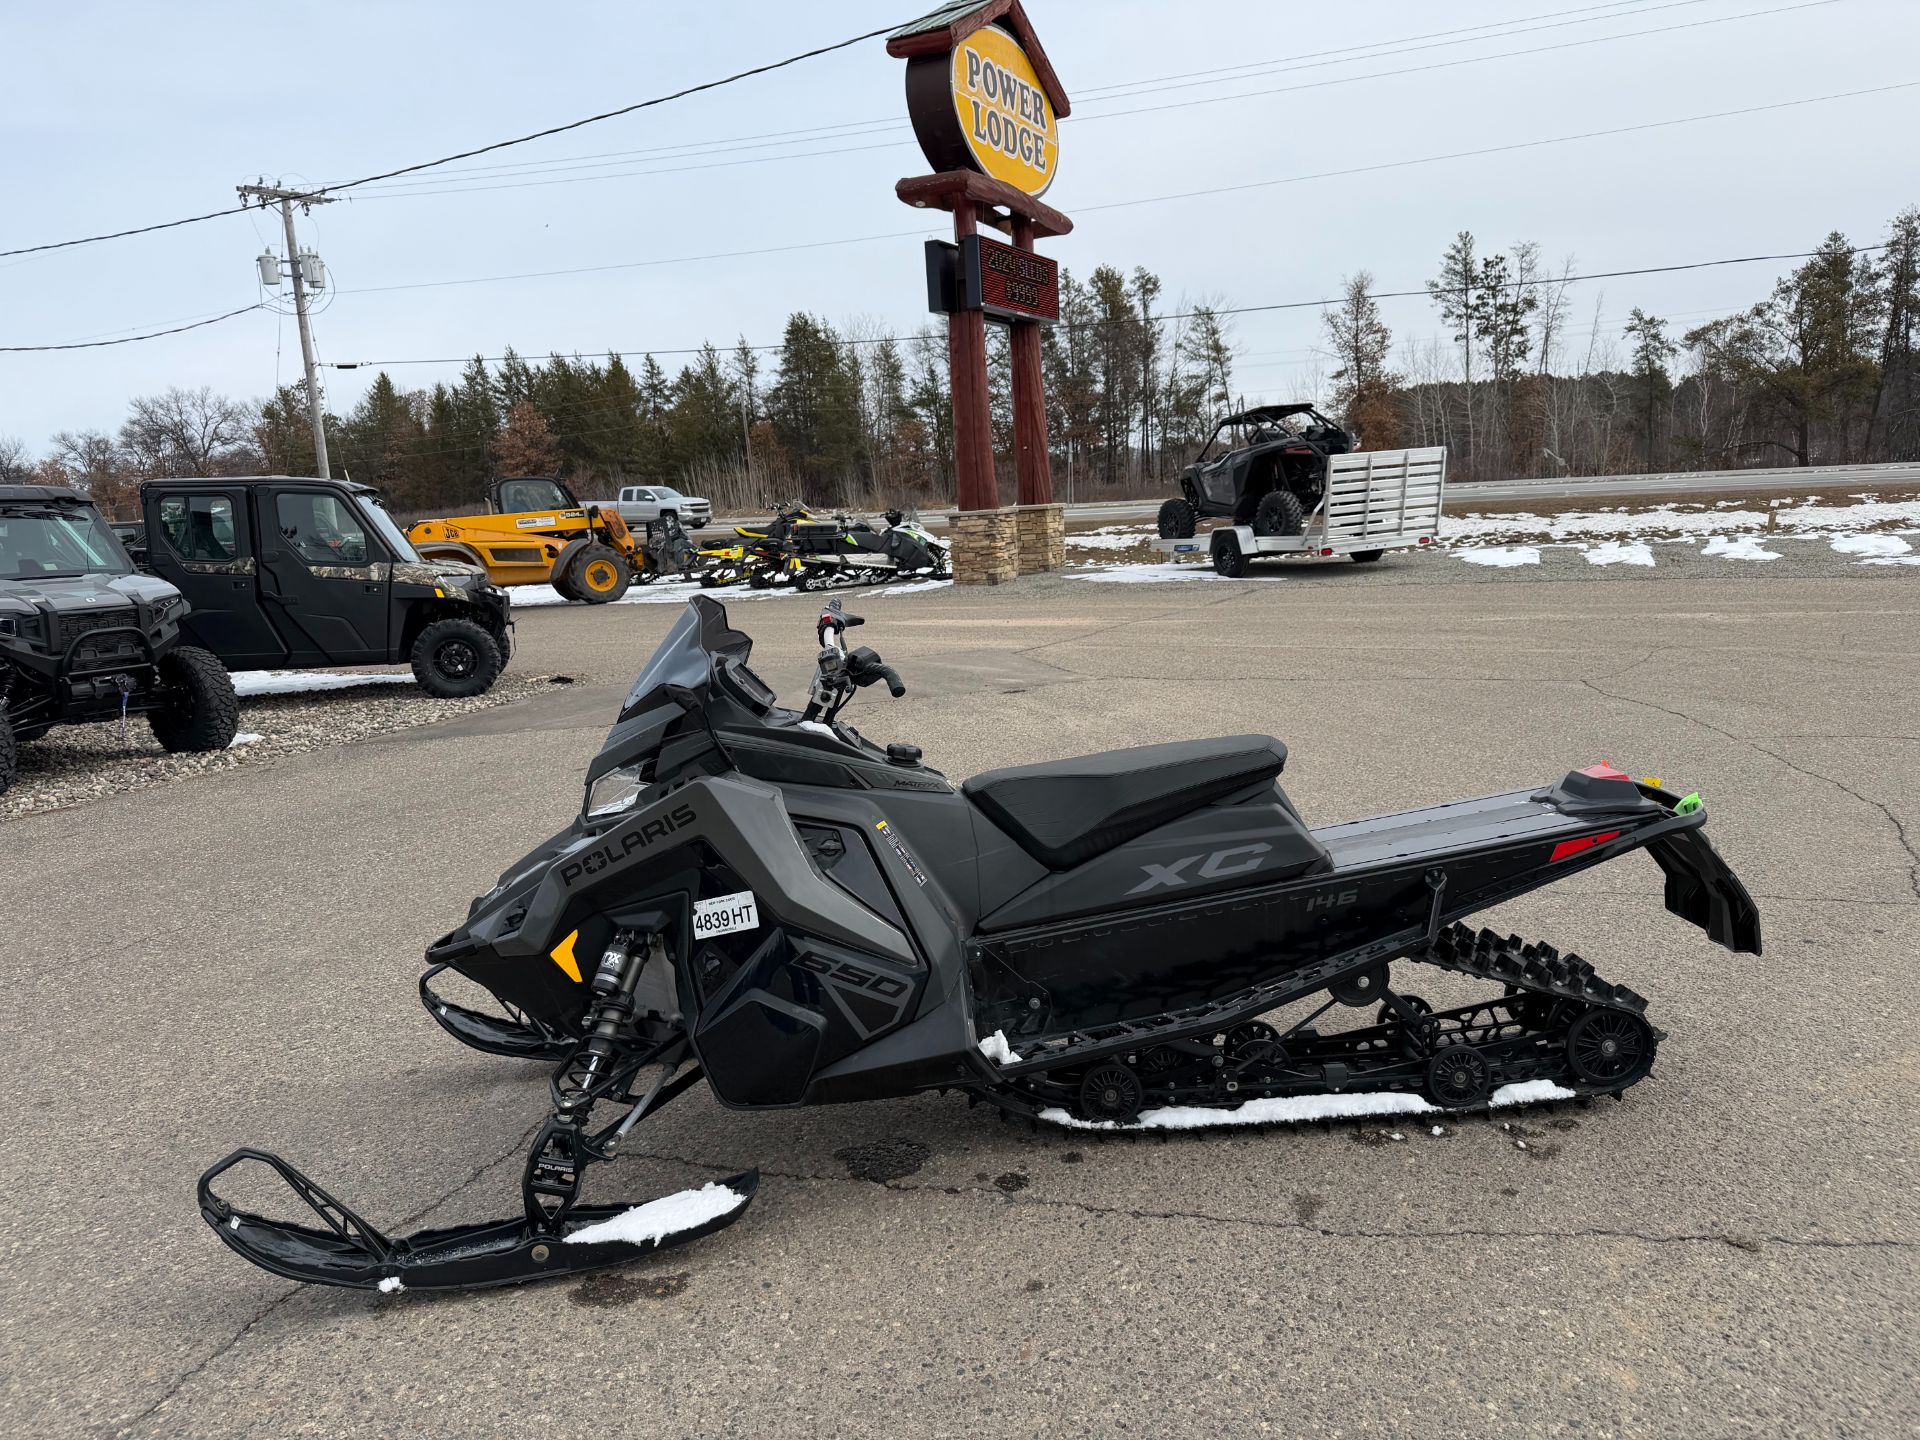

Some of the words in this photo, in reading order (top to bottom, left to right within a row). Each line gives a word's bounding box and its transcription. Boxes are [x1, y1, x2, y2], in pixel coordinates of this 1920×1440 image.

[966, 49, 1047, 130] POWER
[972, 100, 1046, 170] LODGE
[1019, 258, 1049, 284] SLEDS
[894, 780, 941, 789] MATRYX
[560, 803, 697, 887] POLARIS
[1123, 842, 1273, 896] XC
[696, 909, 730, 932] 4839
[731, 904, 753, 926] HT
[1306, 889, 1358, 912] 146
[793, 950, 909, 999] 650
[538, 1163, 574, 1173] POLARIS
